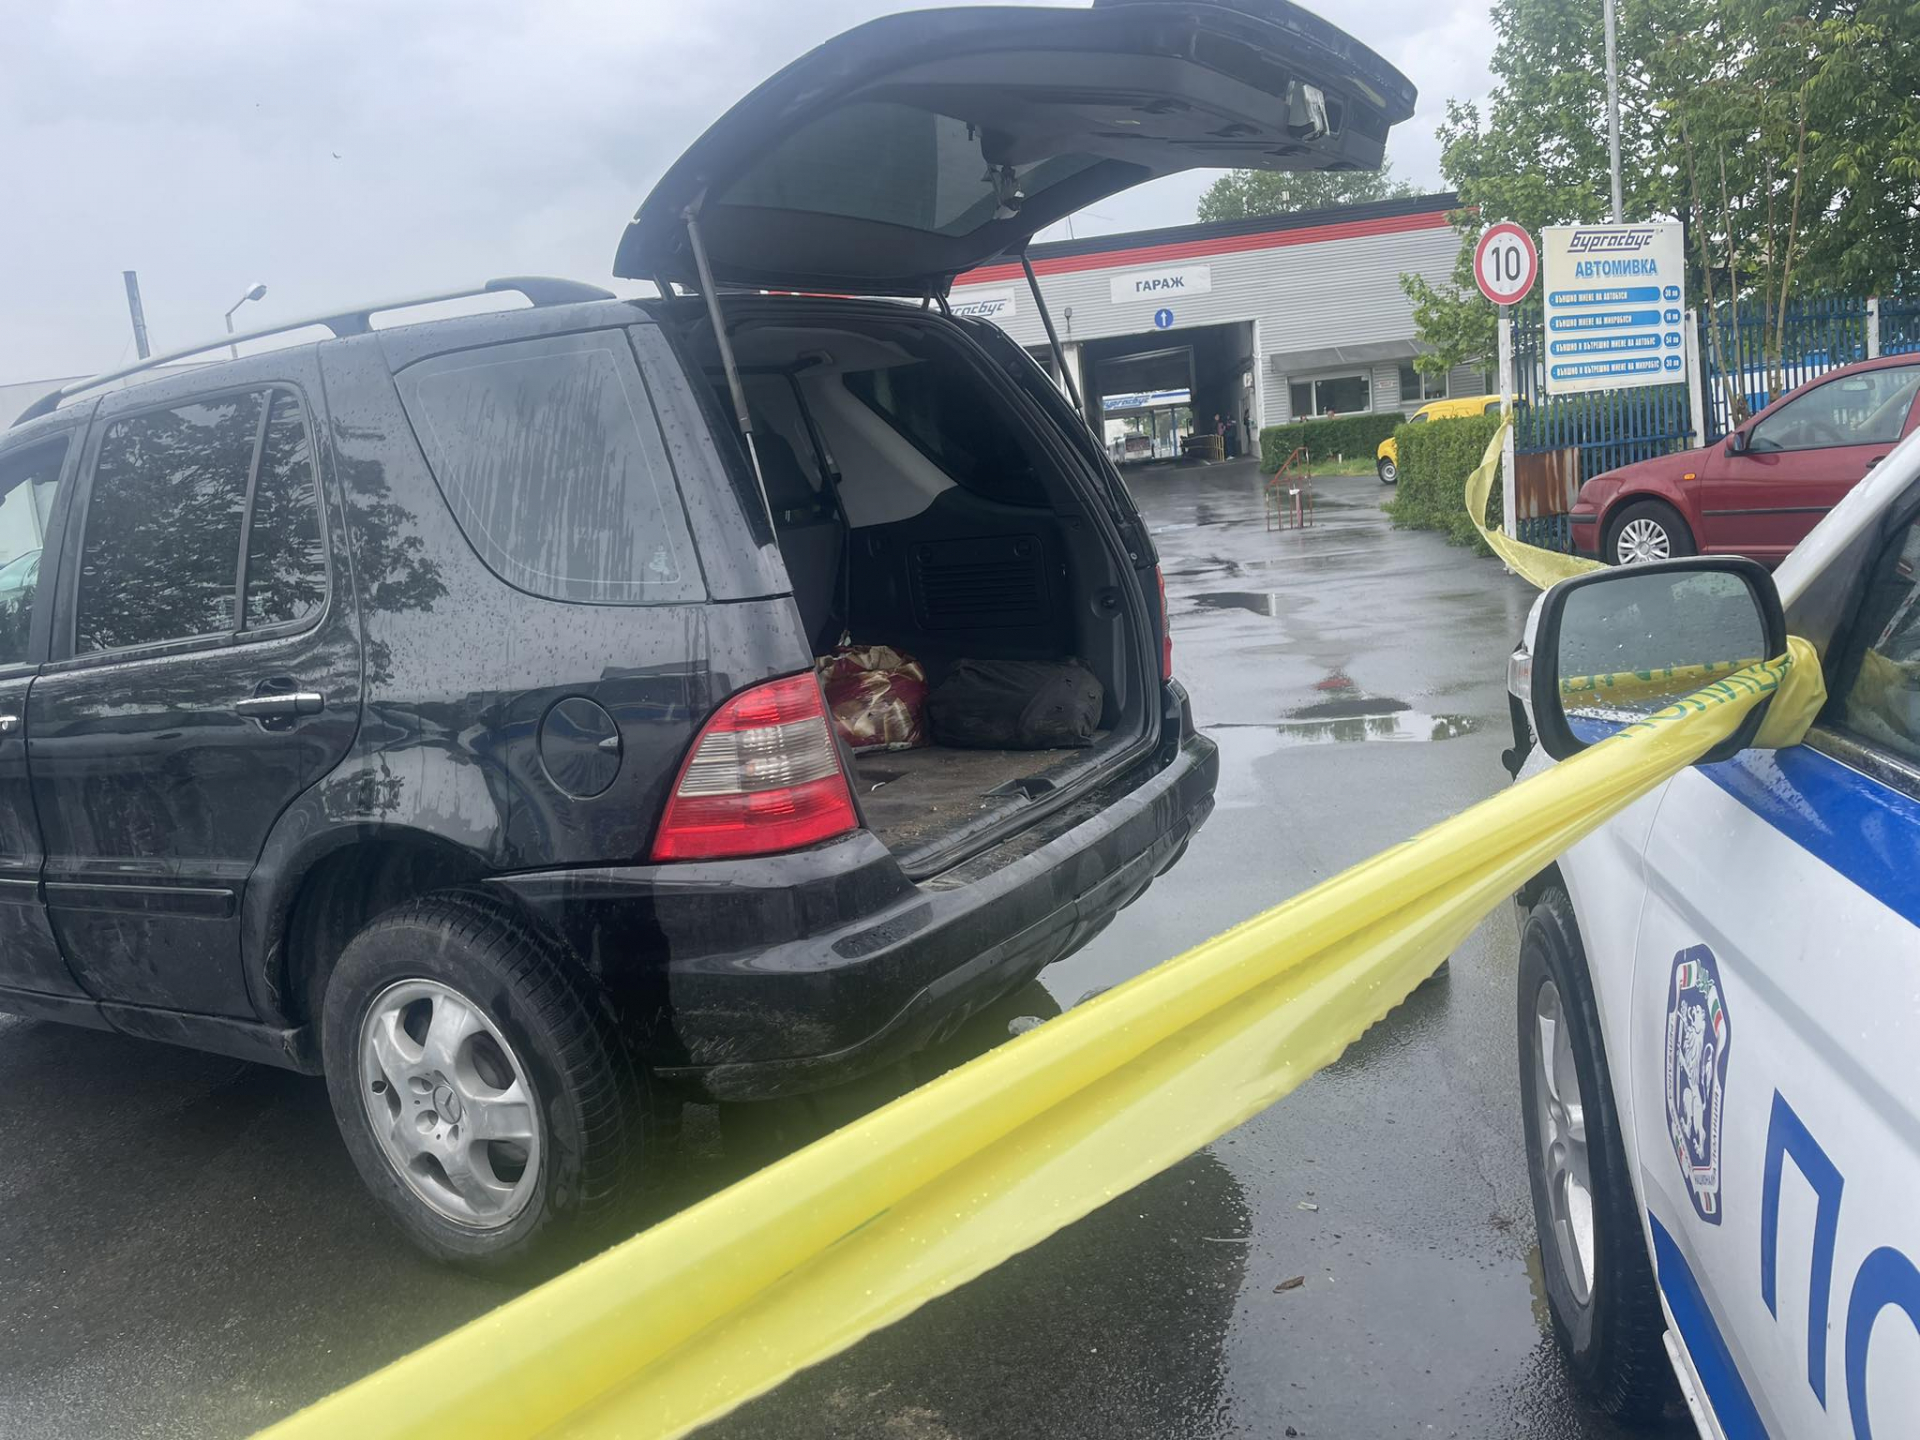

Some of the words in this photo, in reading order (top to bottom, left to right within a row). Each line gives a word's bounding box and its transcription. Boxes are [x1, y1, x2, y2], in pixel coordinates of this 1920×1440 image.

[1491, 246, 1521, 281] 10
[1575, 258, 1658, 277] АВТОМИВКА
[1135, 275, 1185, 292] ГАРАЖ
[1596, 293, 1602, 301] НА
[1596, 317, 1602, 325] НА
[1628, 362, 1634, 370] НА
